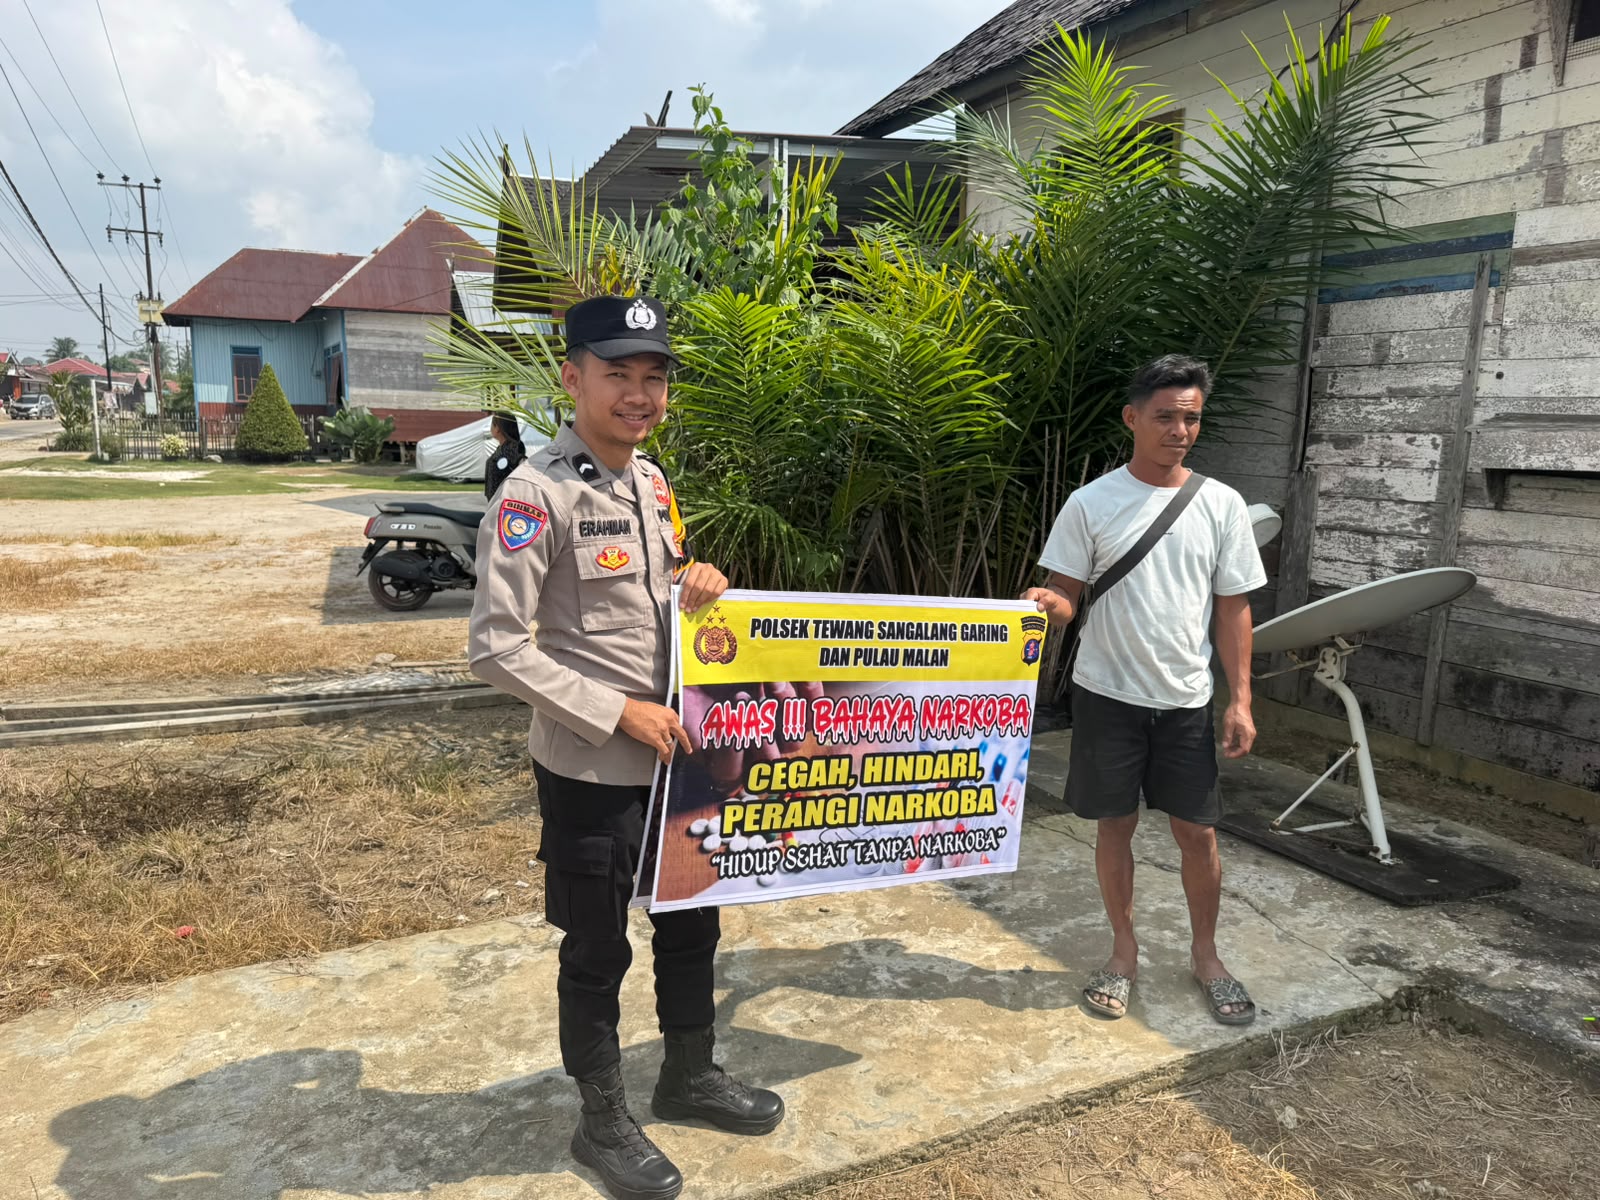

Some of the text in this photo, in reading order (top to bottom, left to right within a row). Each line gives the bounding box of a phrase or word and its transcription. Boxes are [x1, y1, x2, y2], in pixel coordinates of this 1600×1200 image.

[750, 617, 1009, 642] POLSEK TEWANG SANGALANG GARING
[819, 647, 949, 667] DAN PULAU MALAN
[701, 698, 779, 750] AWAS
[812, 694, 917, 744] BAHAYA
[919, 694, 1031, 741] NARKOBA
[747, 750, 984, 792] CEGAH, HINDARI,
[722, 787, 996, 835] PERANGI NARKOBA
[783, 842, 850, 870] SEHAT
[853, 837, 917, 864] TANPA
